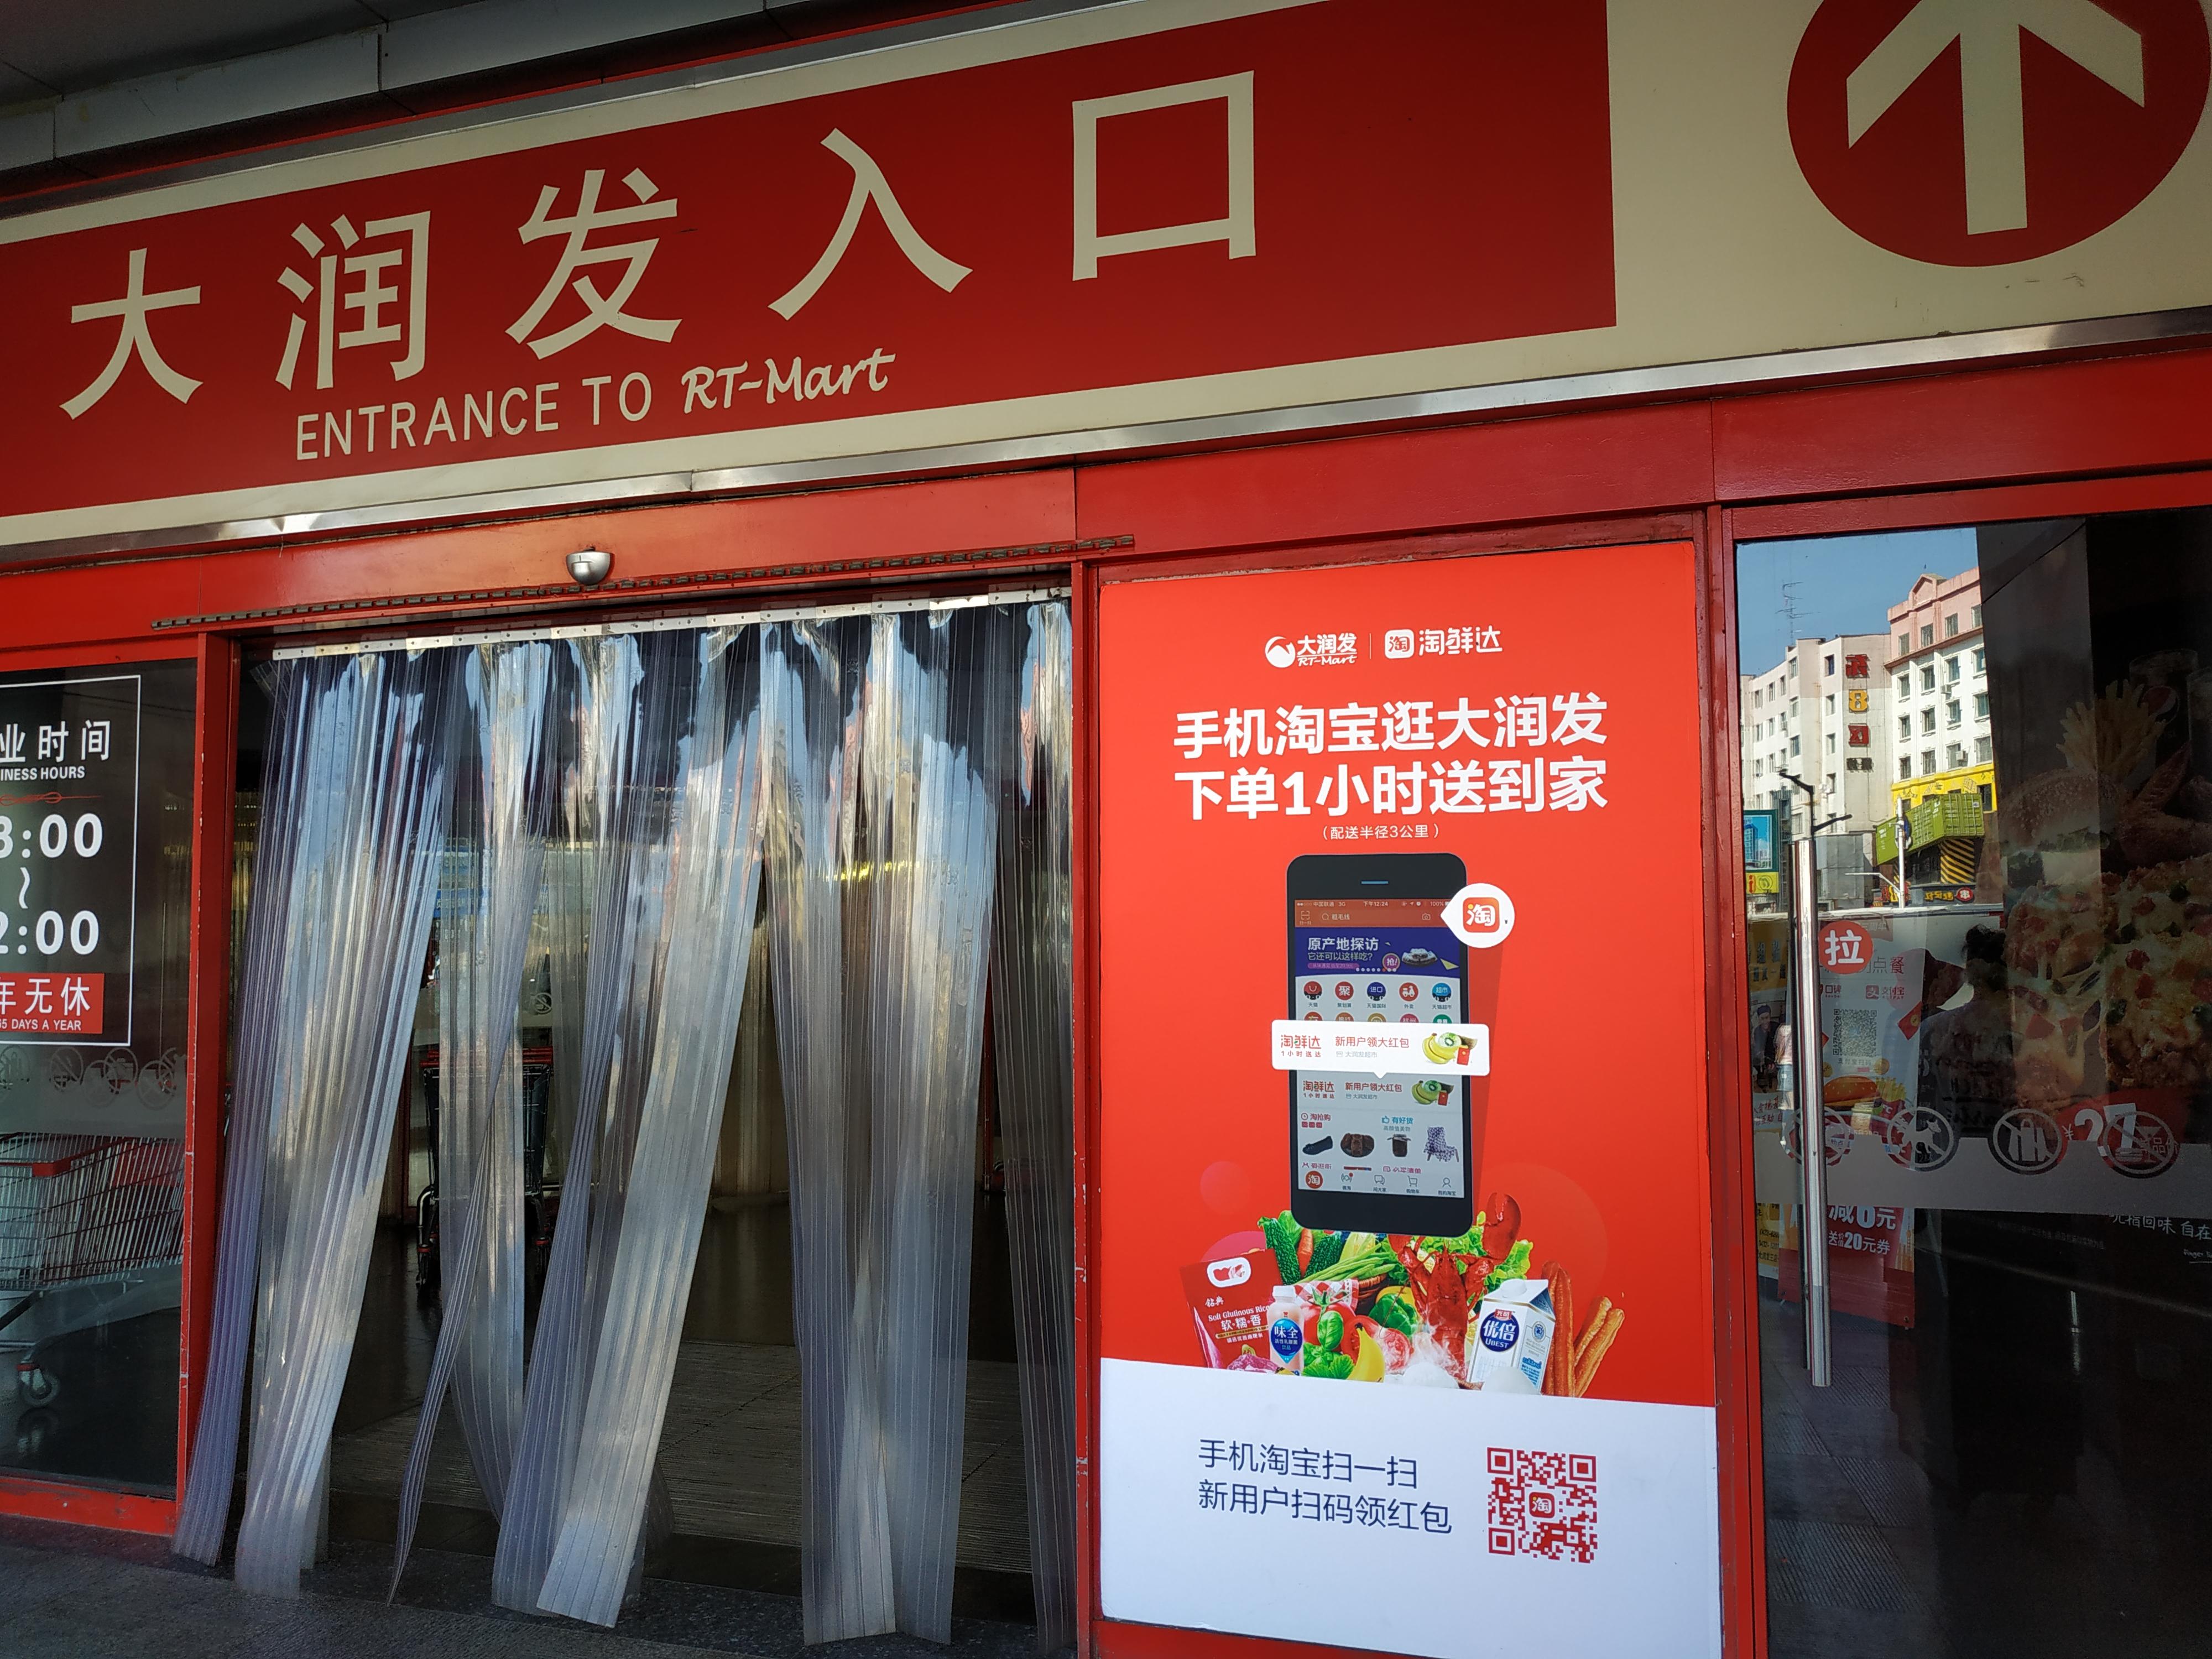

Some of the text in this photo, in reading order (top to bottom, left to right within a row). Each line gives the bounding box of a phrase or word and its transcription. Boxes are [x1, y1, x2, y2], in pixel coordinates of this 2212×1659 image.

[60, 70, 1255, 420] 大润发入口
[297, 348, 896, 460] ENTRANCE TO RT-Mart
[1297, 632, 1357, 655] 大润发
[1418, 625, 1503, 656] 淘鲜达
[1298, 655, 1357, 667] RT-Mart
[1173, 692, 1608, 760] 手机淘宝逛大润发
[0, 719, 111, 763] 业时间
[40, 766, 85, 780] HOURS
[1174, 755, 1608, 821] 下单1小时送到家
[1466, 904, 1496, 926] 淘
[1307, 937, 1379, 951] 原产地探访
[1824, 930, 1864, 966] 拉
[1307, 952, 1373, 961] 它还可以这样吃?
[0, 977, 91, 1016] 年无休
[1339, 985, 1351, 996] 聚
[12, 1019, 38, 1030] DAYS
[42, 1020, 49, 1030] A
[54, 1020, 81, 1031] YEAR
[1280, 1034, 1322, 1050] 淘鲜达
[1335, 1036, 1410, 1048] 新用户领大红包
[1345, 1050, 1378, 1058] 大润发超市
[1303, 1080, 1335, 1092] 淘鲜达
[1345, 1082, 1402, 1092] 新用户领大红包
[1391, 1117, 1413, 1125] 有好货
[1308, 1175, 1320, 1186] 淘
[1208, 1313, 1221, 1322] Soft
[1222, 1307, 1255, 1319] Glutinous
[1496, 1310, 1510, 1318] 光明
[1274, 1325, 1298, 1339] 味全
[1483, 1320, 1516, 1342] 优倍
[1485, 1338, 1509, 1349] UBEST
[1198, 1439, 1418, 1489] 手机淘宝扫一扫
[1198, 1478, 1453, 1535] 新用户扫码领红包
